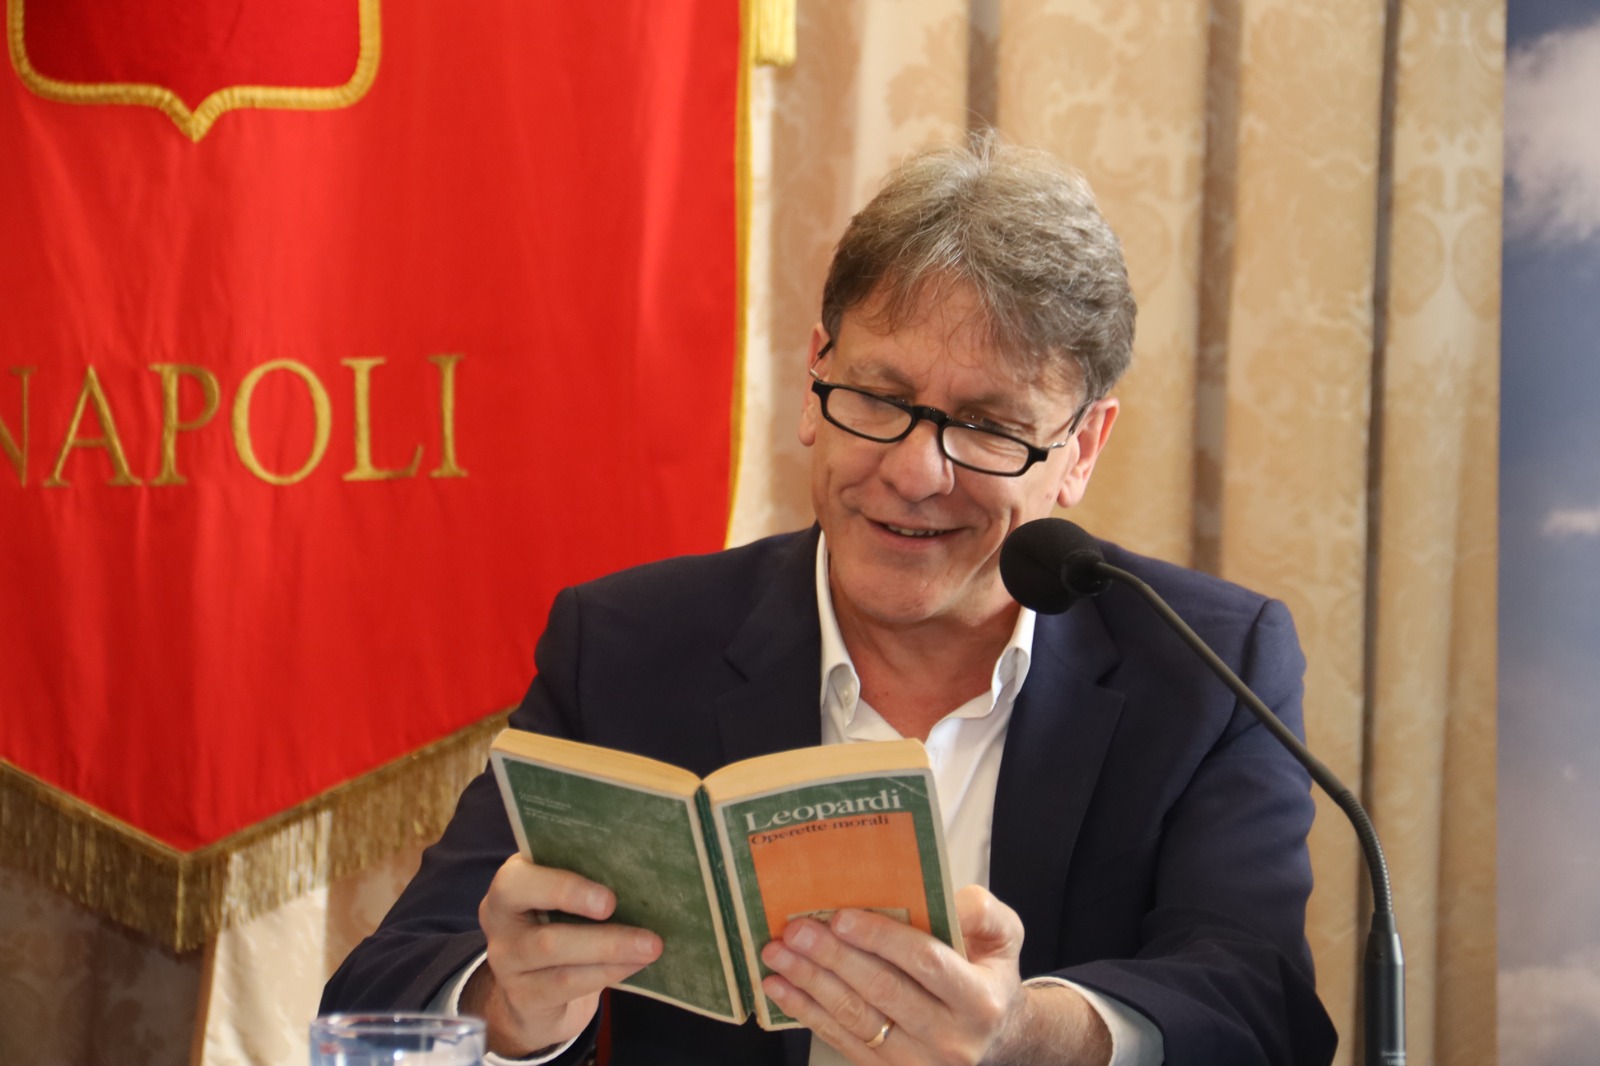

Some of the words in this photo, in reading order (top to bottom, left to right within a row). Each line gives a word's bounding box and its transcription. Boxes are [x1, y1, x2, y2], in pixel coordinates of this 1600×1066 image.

[743, 789, 903, 832] Leopardi
[751, 822, 827, 846] Operette
[832, 813, 889, 830] morali
